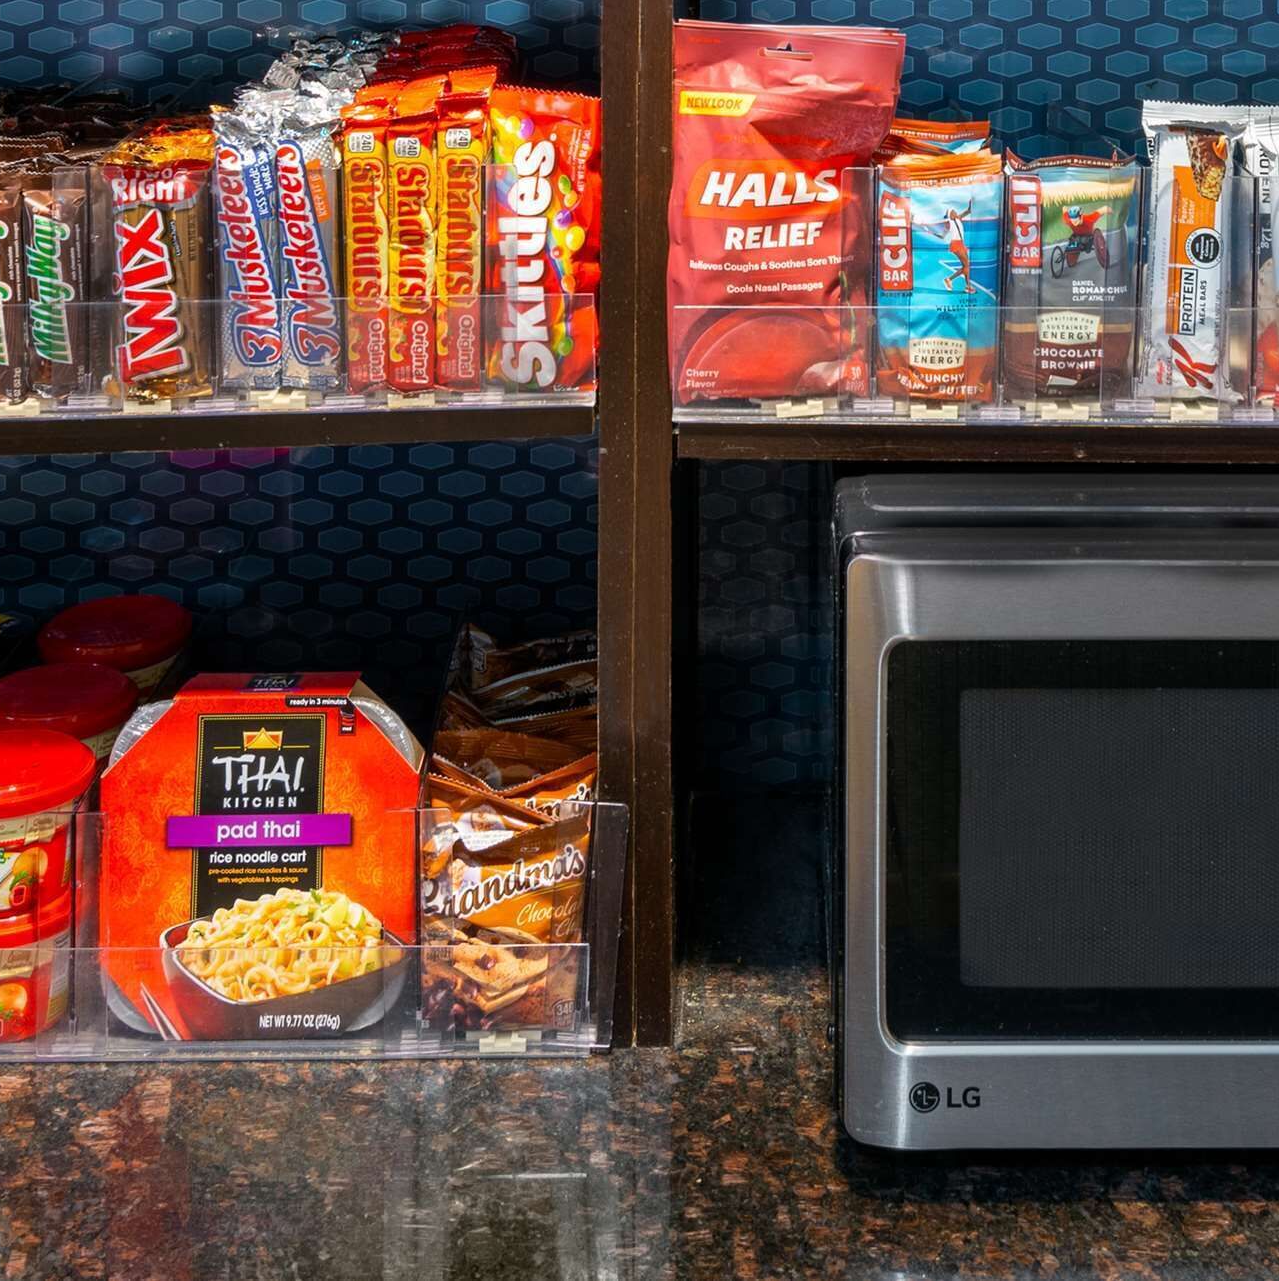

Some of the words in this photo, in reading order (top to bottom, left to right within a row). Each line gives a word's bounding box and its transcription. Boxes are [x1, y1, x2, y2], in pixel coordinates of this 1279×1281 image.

[699, 169, 840, 208] HALLS
[724, 222, 822, 251] RELIEF
[1013, 246, 1040, 258] BAR
[726, 283, 752, 294] Cools
[754, 283, 780, 293] Nasal
[781, 281, 823, 292] Passages
[118, 209, 188, 383] TWIX
[1184, 272, 1195, 333] PROTEIN
[368, 317, 386, 382] Original
[1033, 347, 1104, 358] CHOCOLATE
[914, 355, 963, 365] ENERGY
[1041, 360, 1095, 370] BROWNIE
[686, 369, 719, 380] Cherry
[686, 379, 716, 390] Flavor
[212, 754, 304, 794] THAI
[223, 797, 297, 808] KITCHEN
[217, 822, 257, 842] pad
[263, 821, 300, 838] thai
[210, 852, 232, 863] rice
[236, 852, 278, 863] noodle
[282, 850, 307, 862] cart
[259, 1015, 273, 1027] NET
[274, 1015, 285, 1027] WT
[286, 1015, 302, 1027] 9.77
[304, 1015, 315, 1027] OZ
[316, 1014, 340, 1029] (276g)
[947, 1087, 981, 1108] LG
